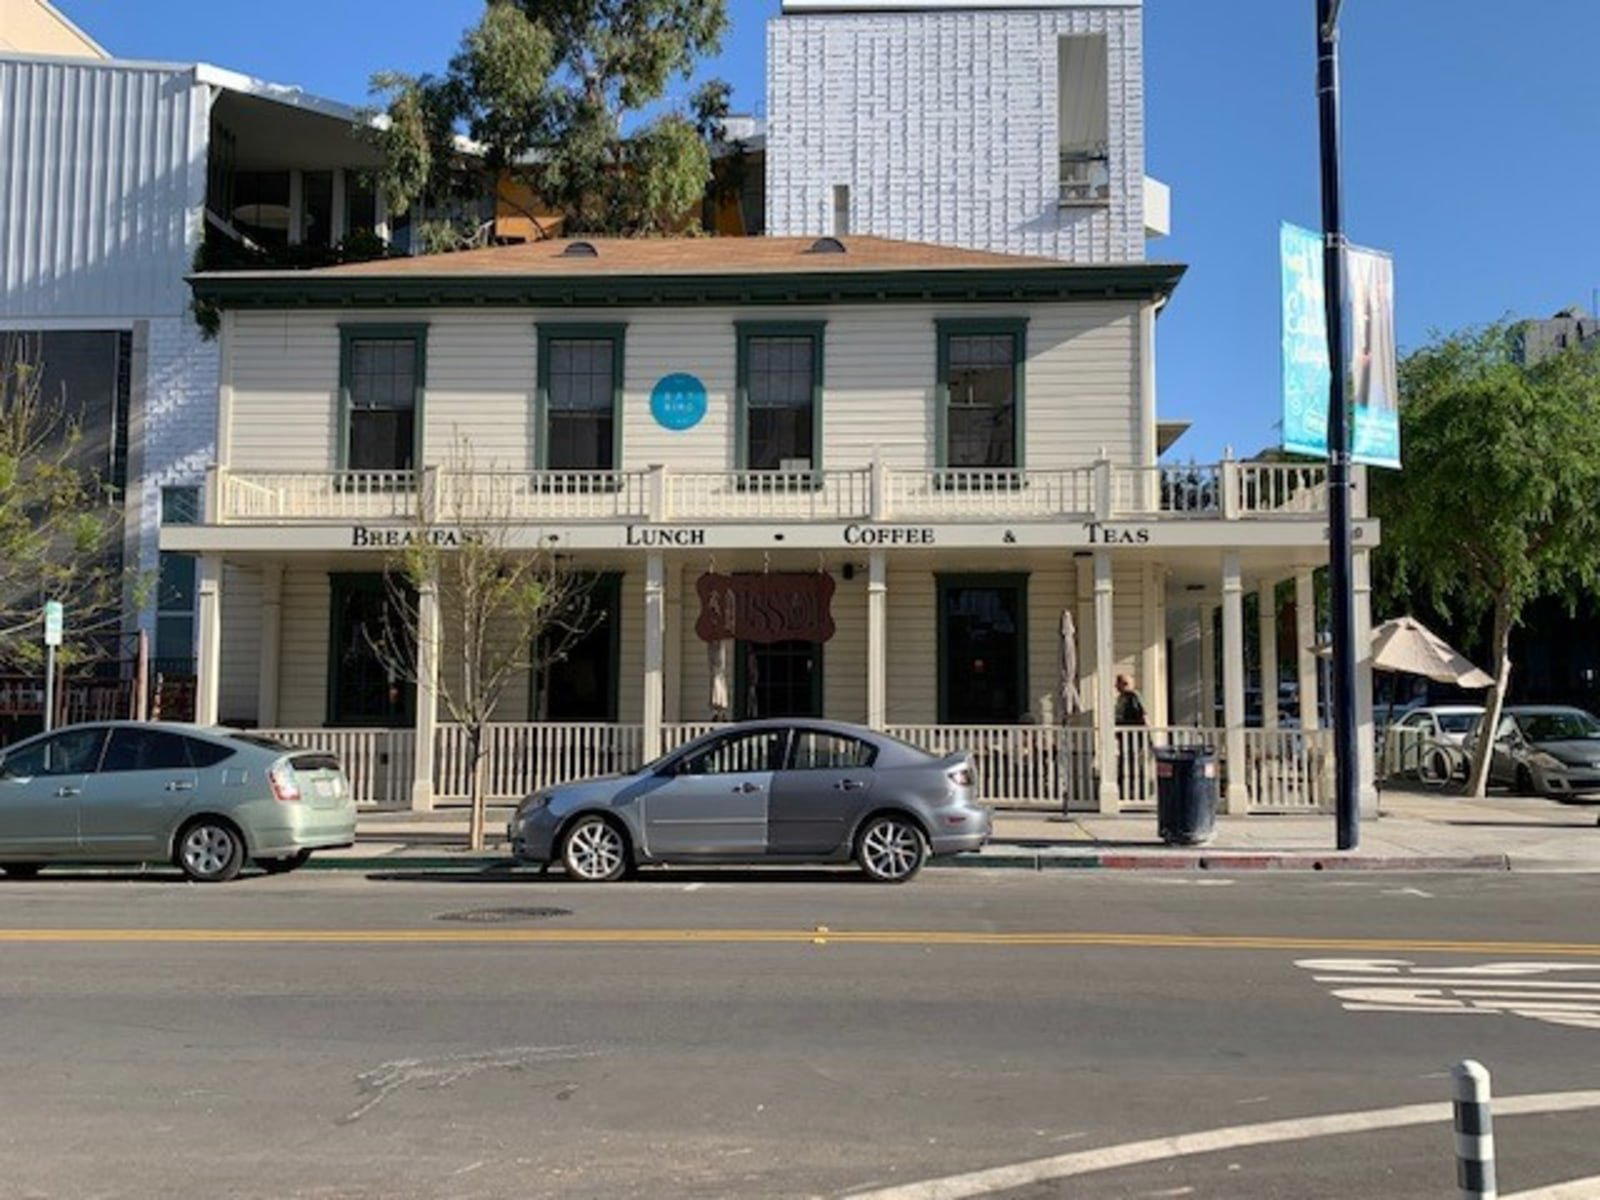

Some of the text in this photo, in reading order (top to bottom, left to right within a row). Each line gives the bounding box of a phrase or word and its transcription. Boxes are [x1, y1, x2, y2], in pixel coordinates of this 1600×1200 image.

[352, 522, 1149, 547] BREAFAS LUNCH COFFEE & TEAS
